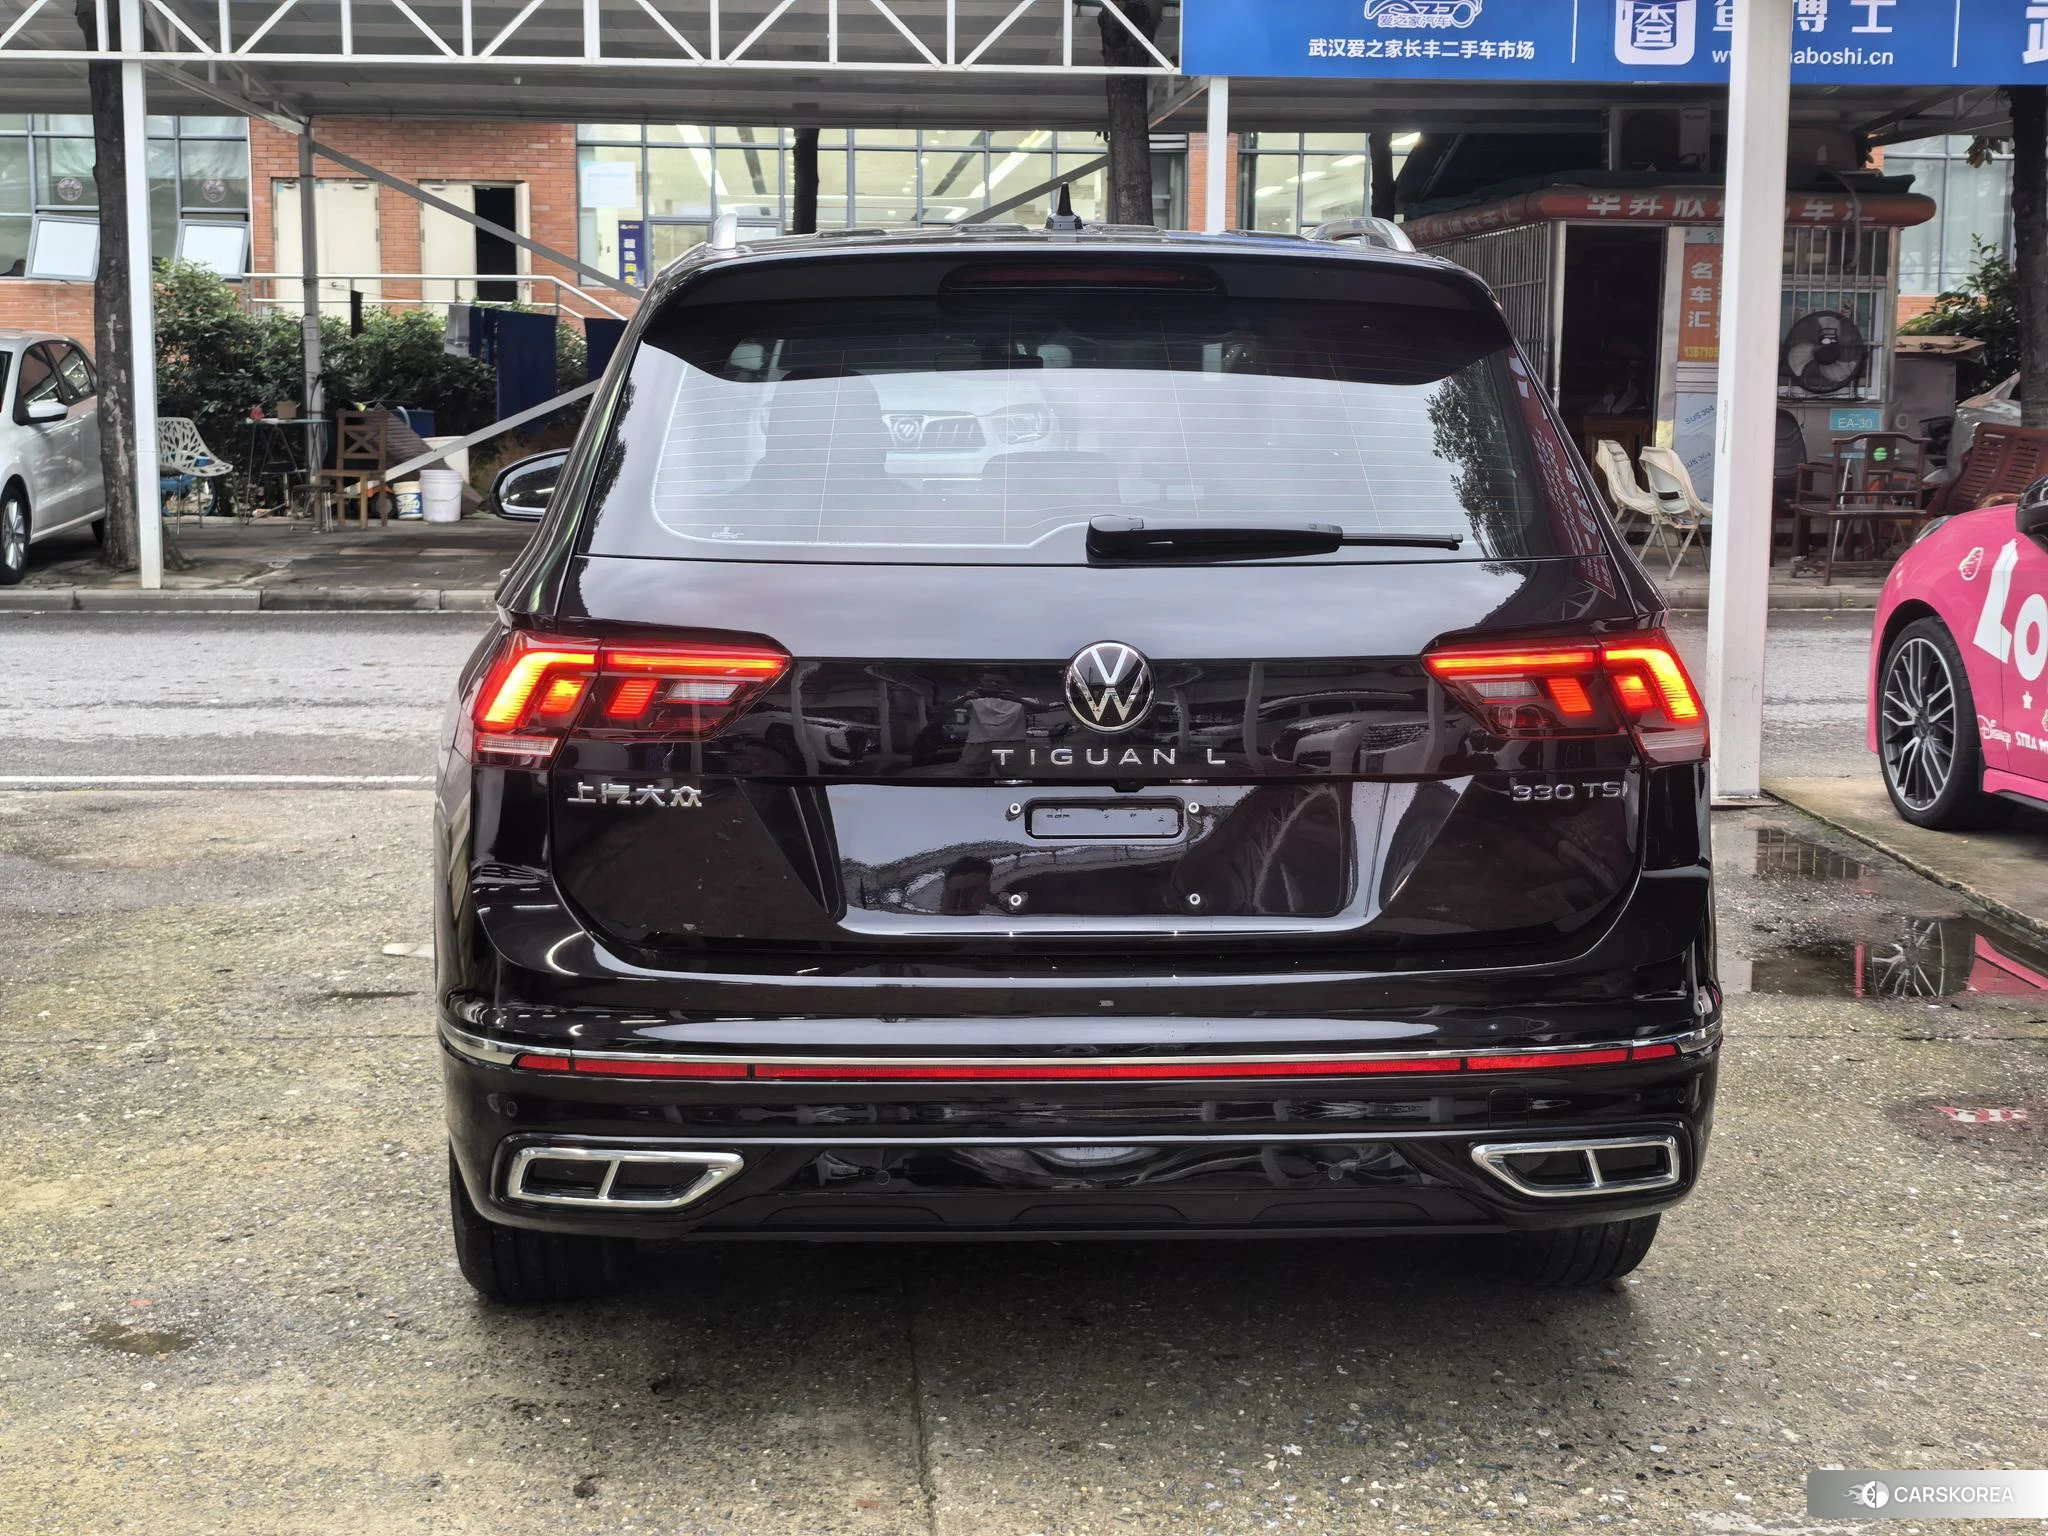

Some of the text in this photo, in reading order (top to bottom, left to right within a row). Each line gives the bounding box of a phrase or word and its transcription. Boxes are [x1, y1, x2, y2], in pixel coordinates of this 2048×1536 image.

[1308, 38, 1535, 59] 武汉爱之家长丰二手车市场
[1687, 261, 1713, 328] 名车汇
[1838, 417, 1873, 429] EA-30
[991, 747, 1226, 766] TIGUAN L
[567, 781, 703, 808] 上汽大众
[1512, 780, 1629, 802] 330 TSI
